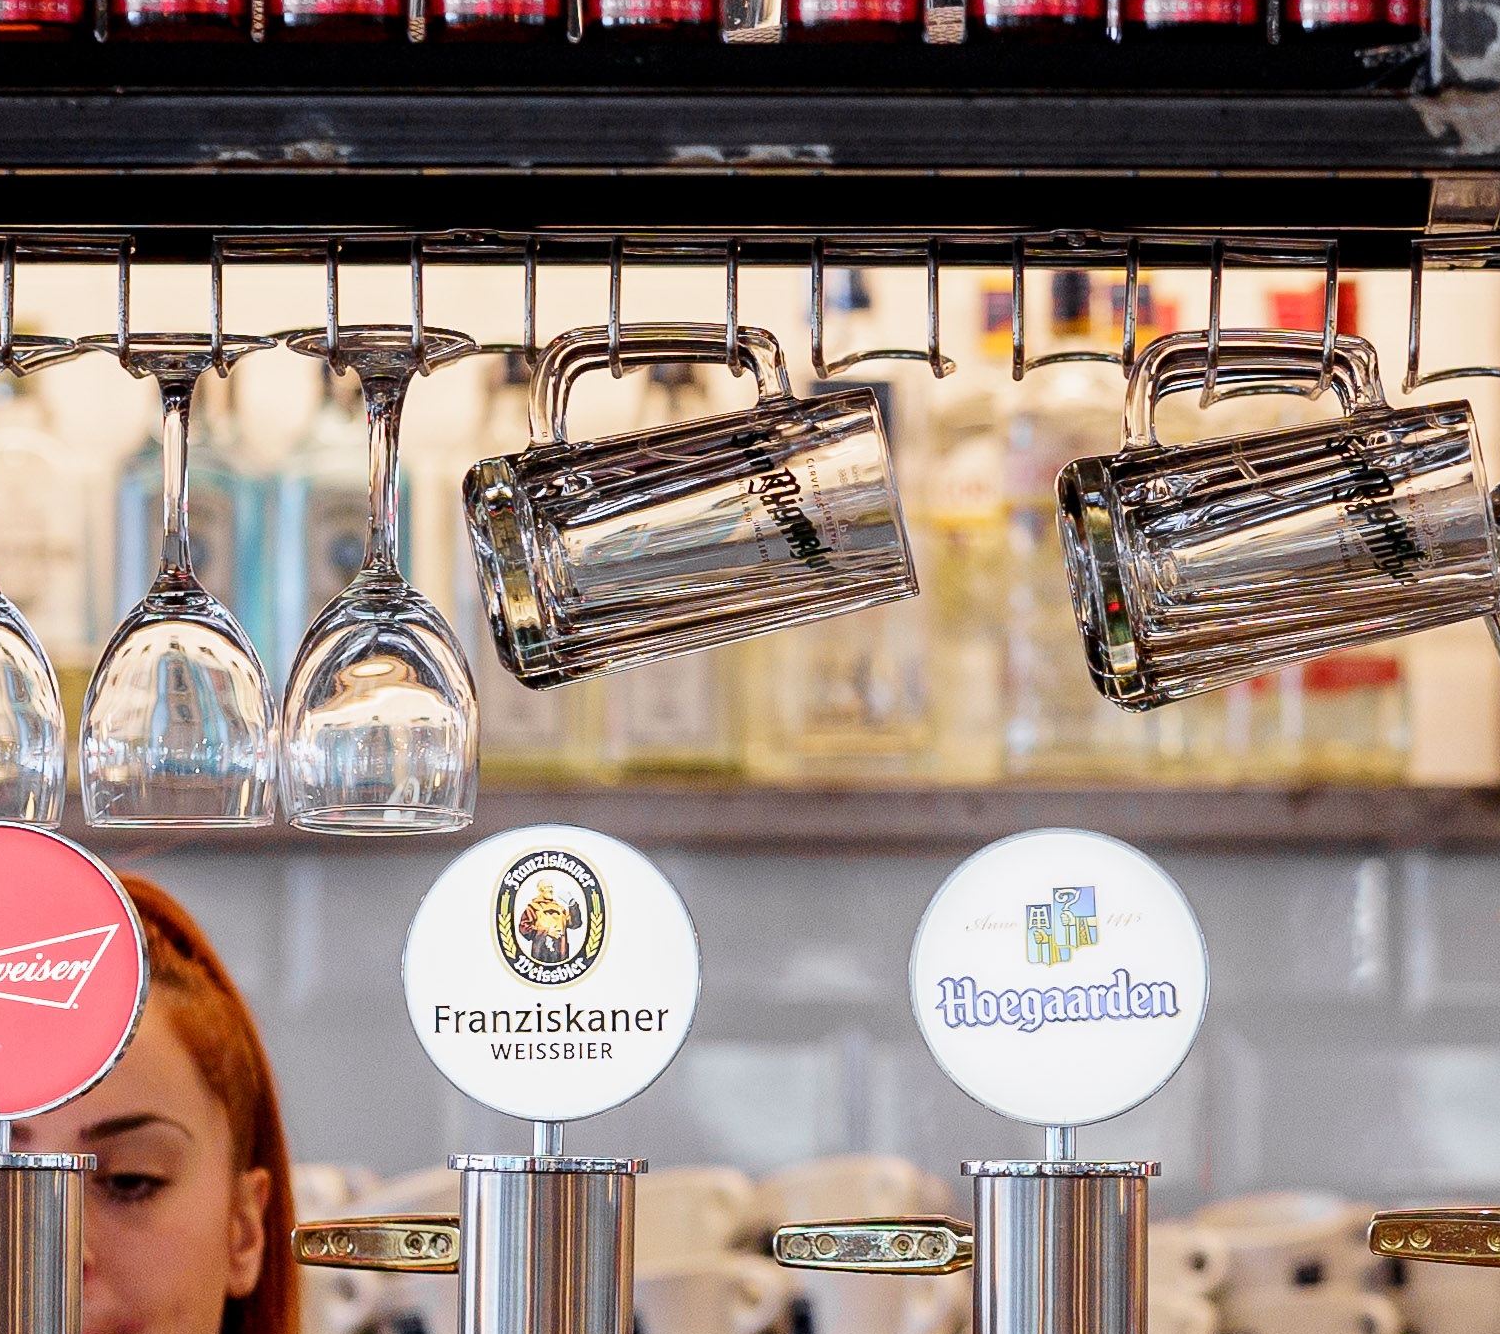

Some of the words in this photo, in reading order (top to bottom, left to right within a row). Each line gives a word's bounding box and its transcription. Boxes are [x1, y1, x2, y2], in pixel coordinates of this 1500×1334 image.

[504, 852, 596, 890] Franziskaner
[513, 955, 587, 983] Weissbier
[935, 968, 1182, 1033] Hoegaarden
[434, 1002, 669, 1034] Franziskaner
[491, 1043, 613, 1060] WEISSBIER
